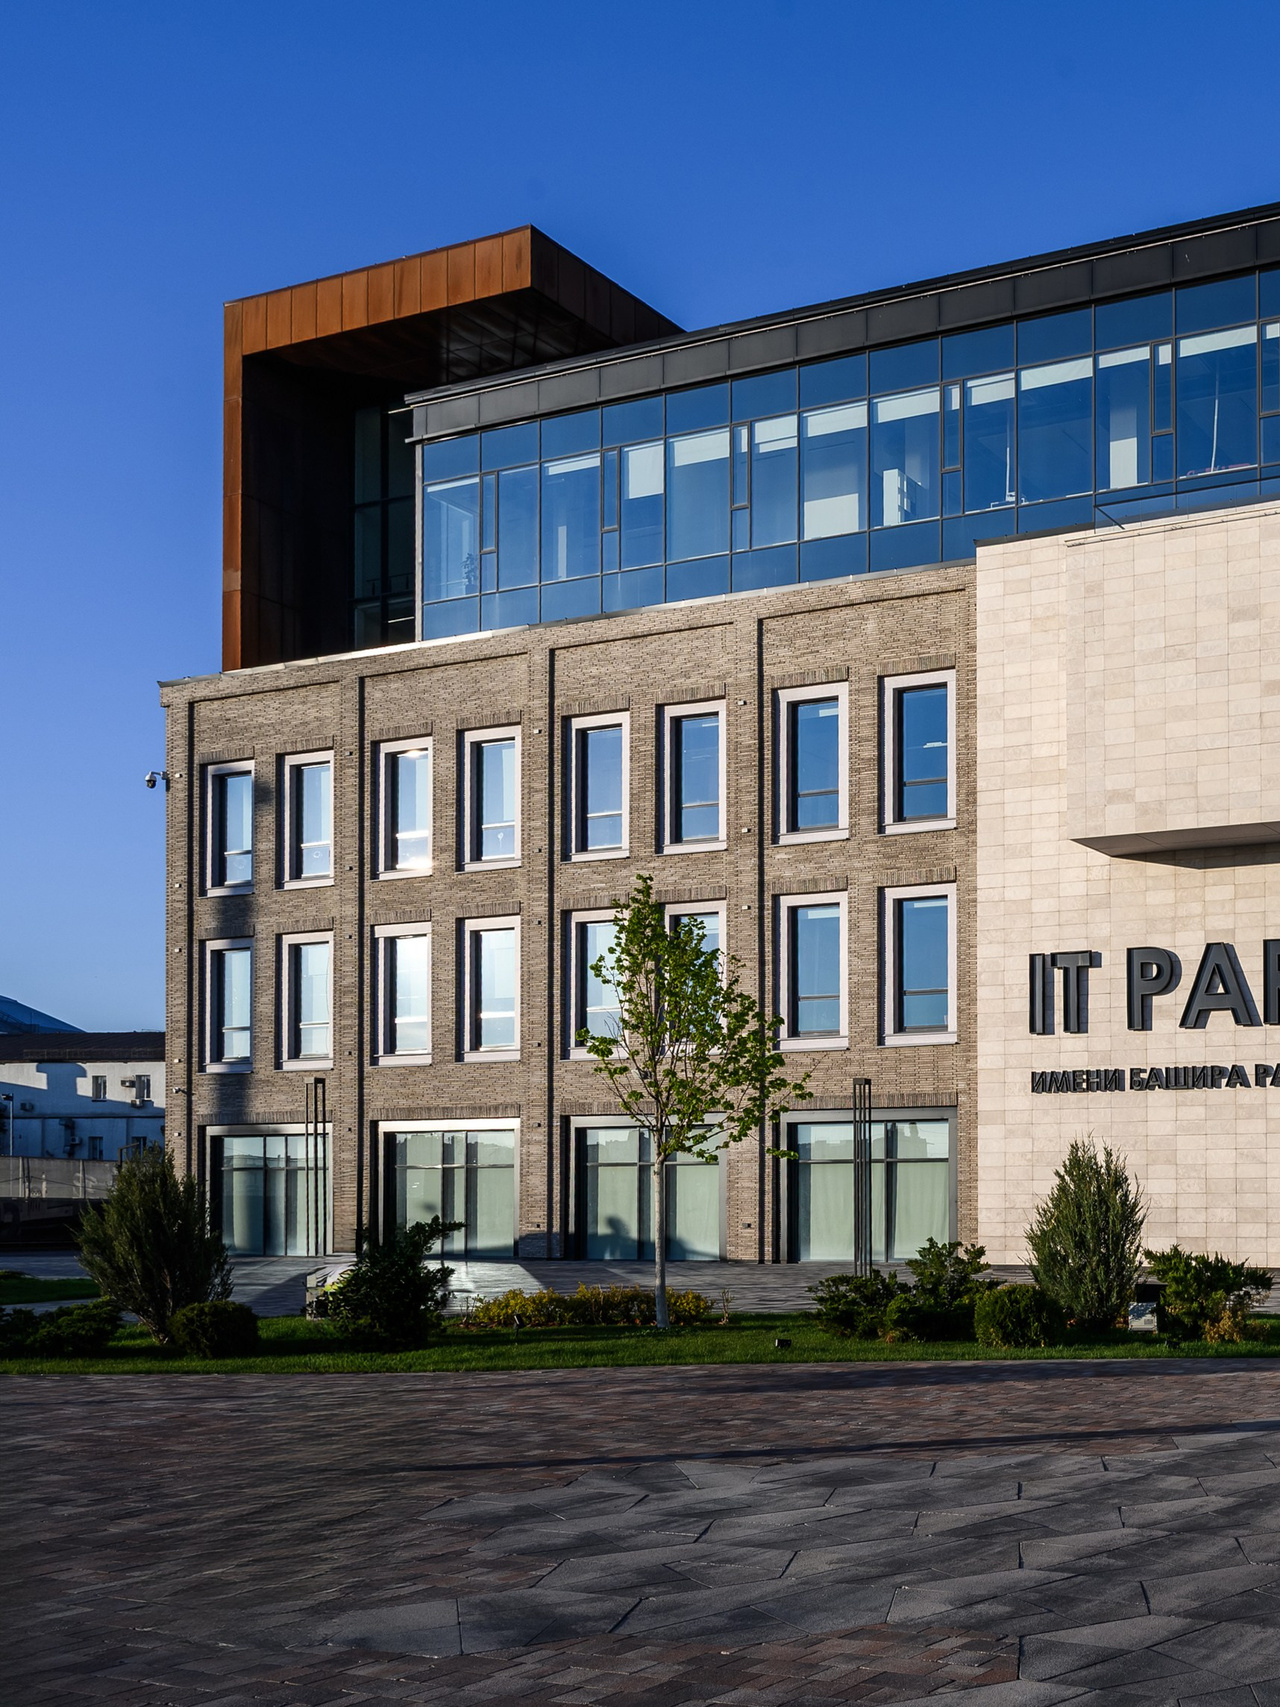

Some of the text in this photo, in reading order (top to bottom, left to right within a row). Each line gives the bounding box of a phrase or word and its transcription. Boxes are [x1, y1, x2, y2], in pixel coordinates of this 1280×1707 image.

[1029, 950, 1096, 1035] IT
[1031, 1068, 1123, 1094] ИМЕНИ
[1130, 1064, 1250, 1091] БАШИРА
